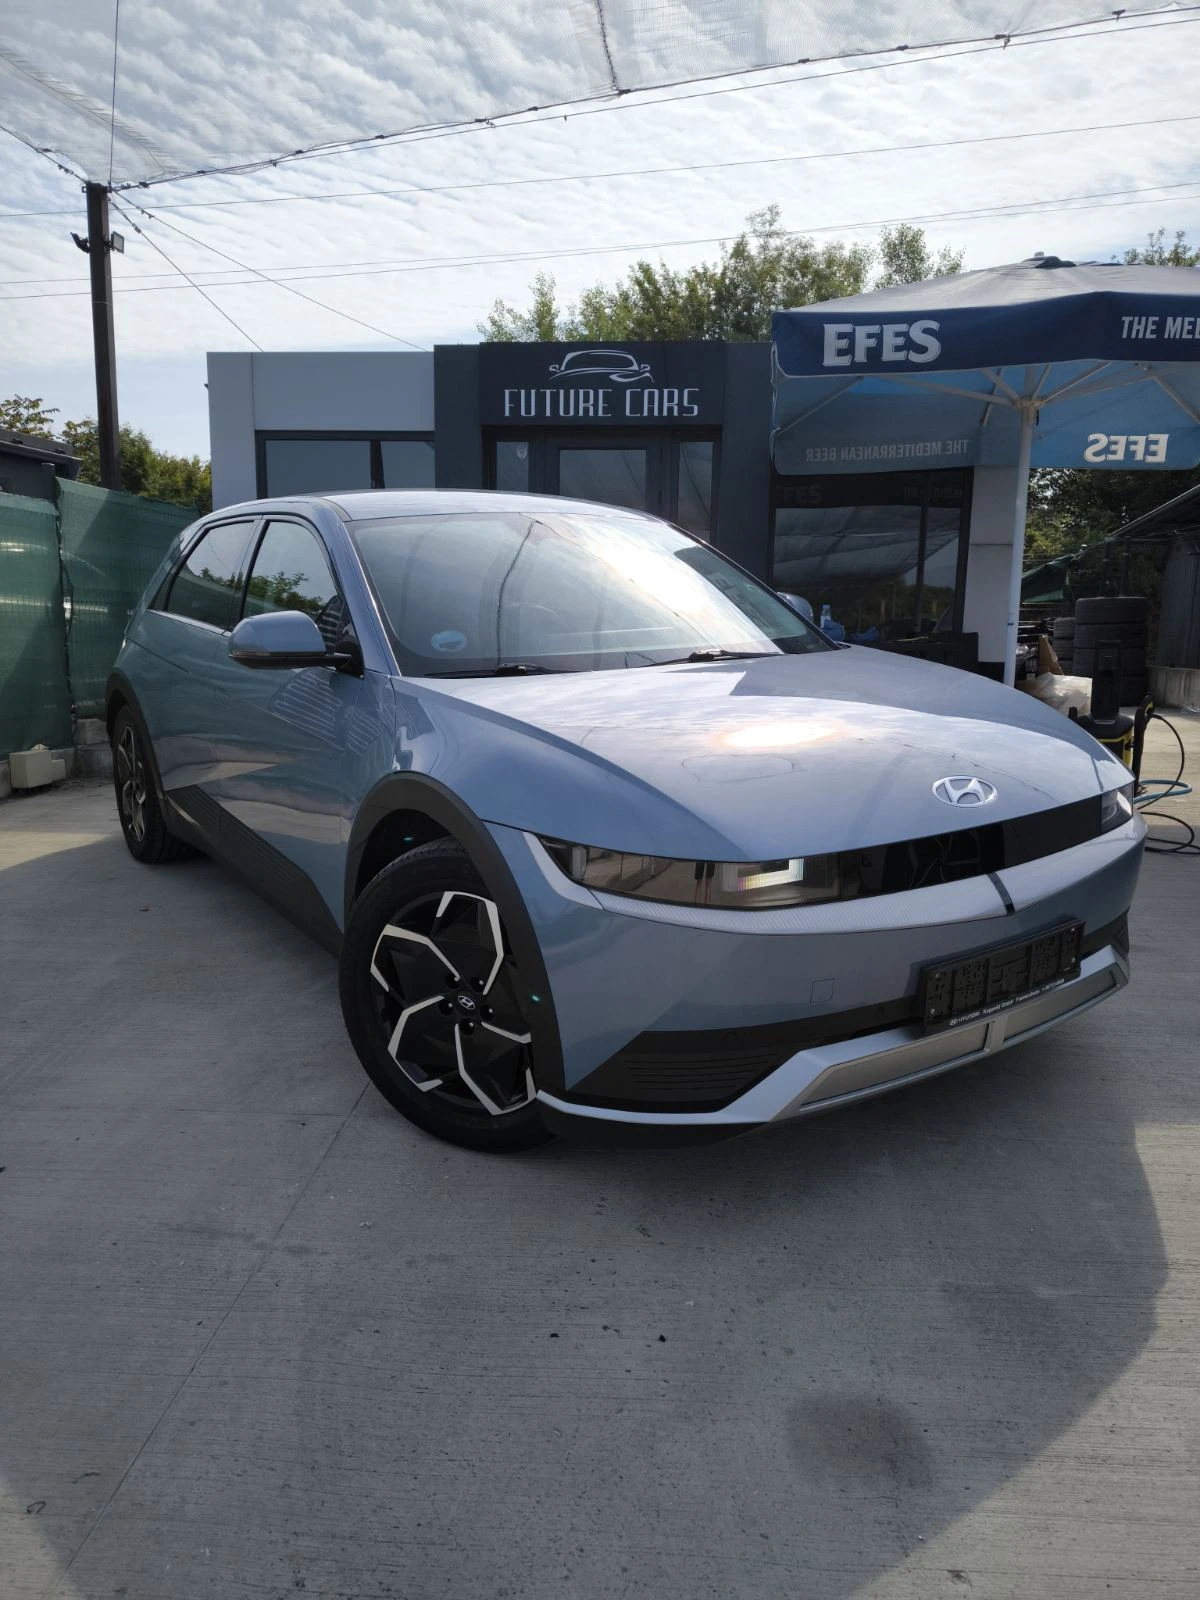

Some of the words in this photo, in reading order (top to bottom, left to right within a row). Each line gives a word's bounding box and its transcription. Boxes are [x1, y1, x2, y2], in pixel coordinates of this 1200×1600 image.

[1121, 315, 1160, 339] THE
[822, 318, 942, 367] EFES
[503, 388, 613, 417] FUTURE
[624, 388, 700, 417] CARS
